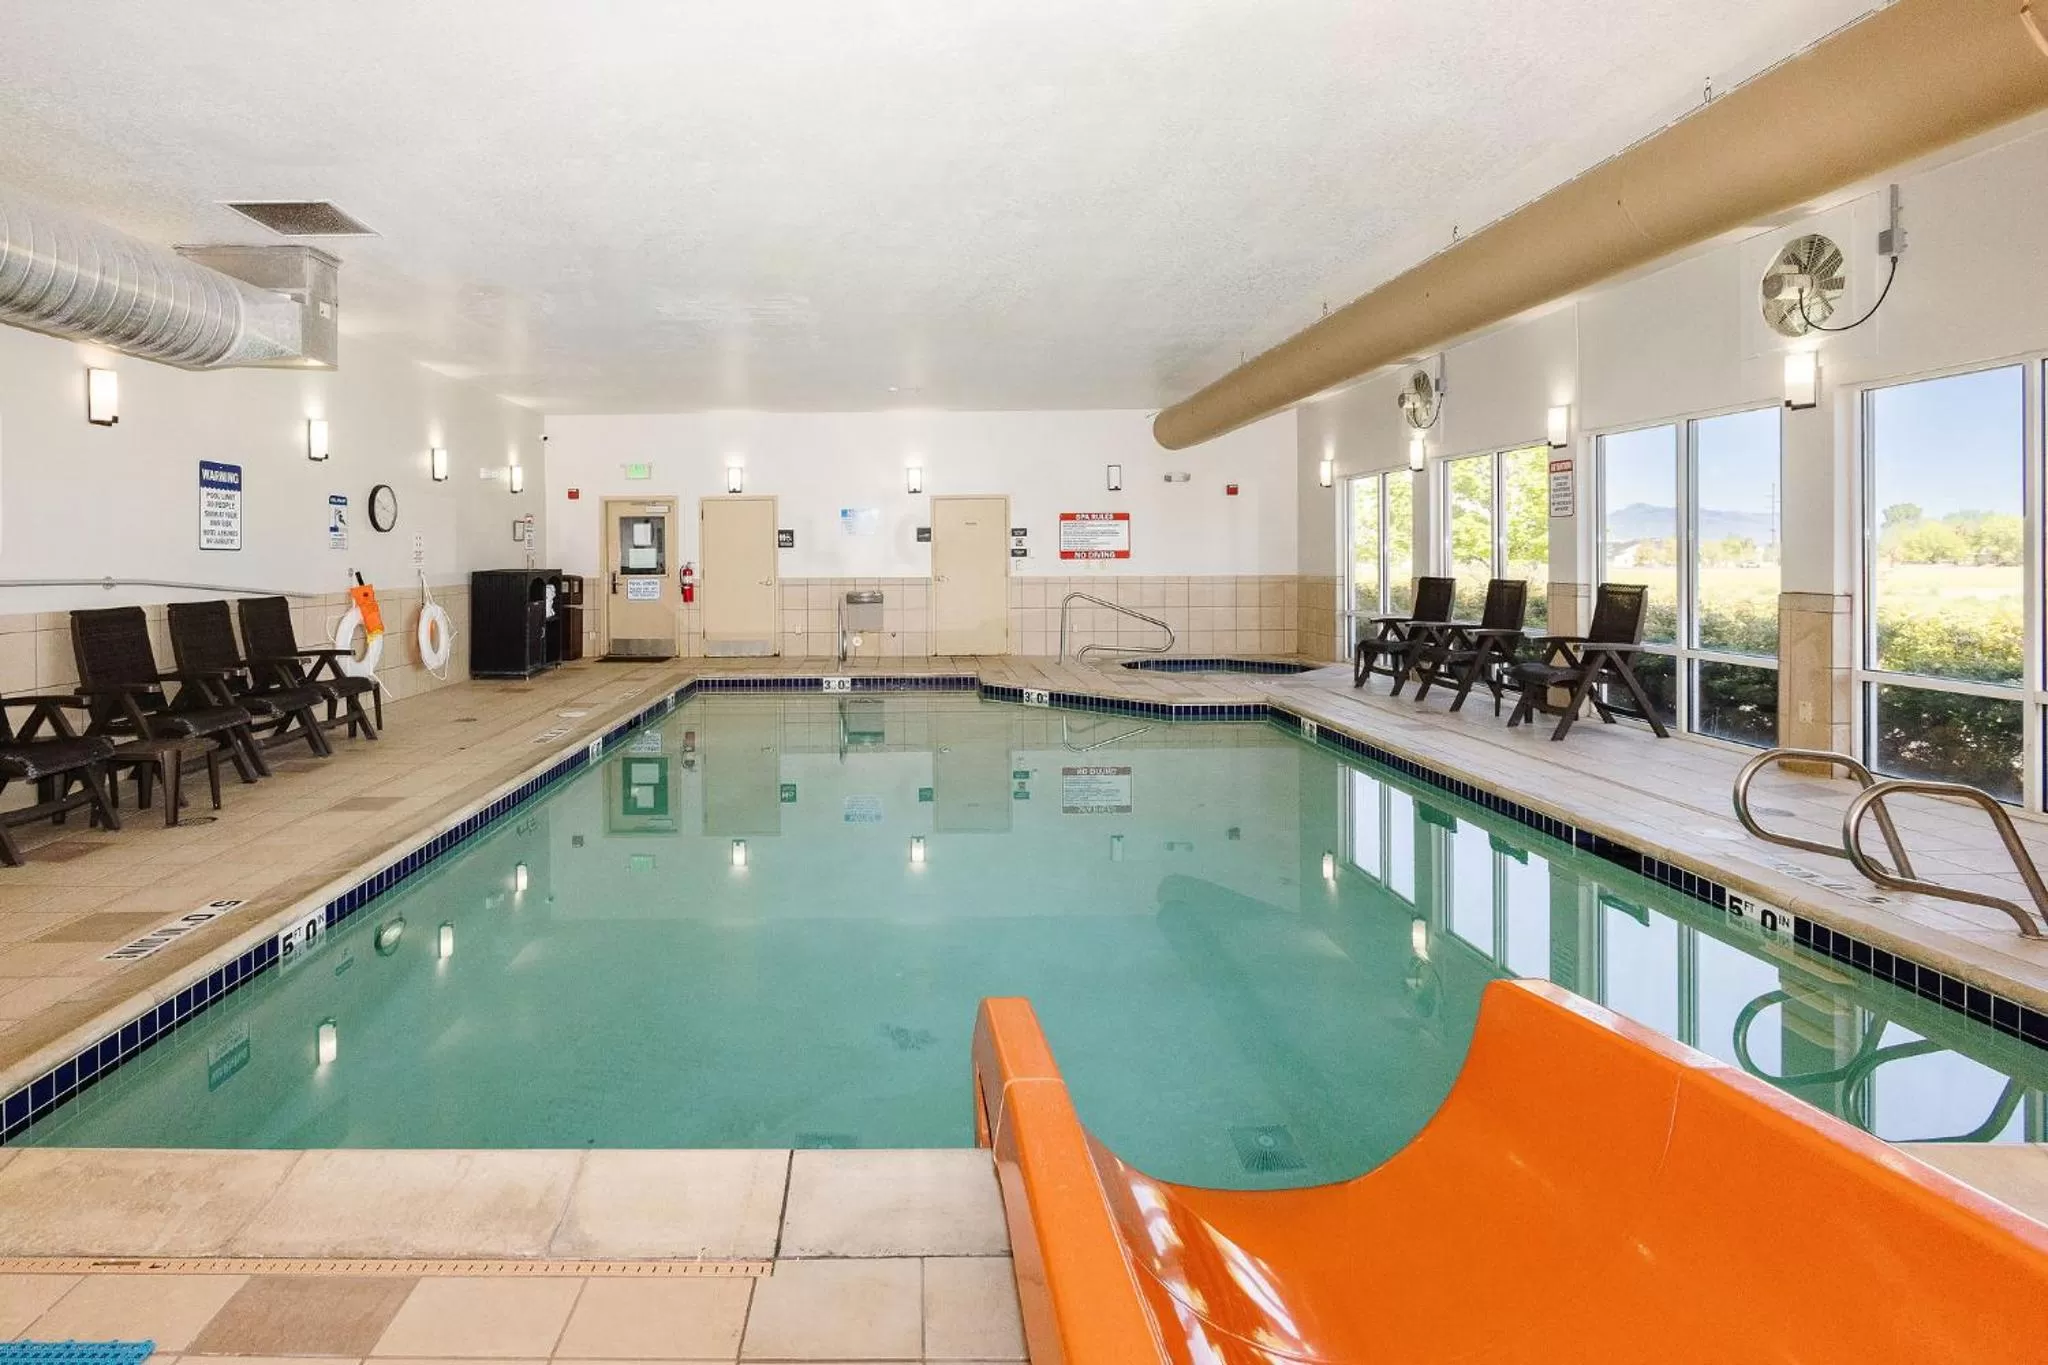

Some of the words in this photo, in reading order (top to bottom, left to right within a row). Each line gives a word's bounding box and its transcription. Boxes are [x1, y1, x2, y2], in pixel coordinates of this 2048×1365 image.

[201, 468, 240, 484] WARNING
[1074, 551, 1086, 559] NO
[1087, 550, 1116, 559] DIVING
